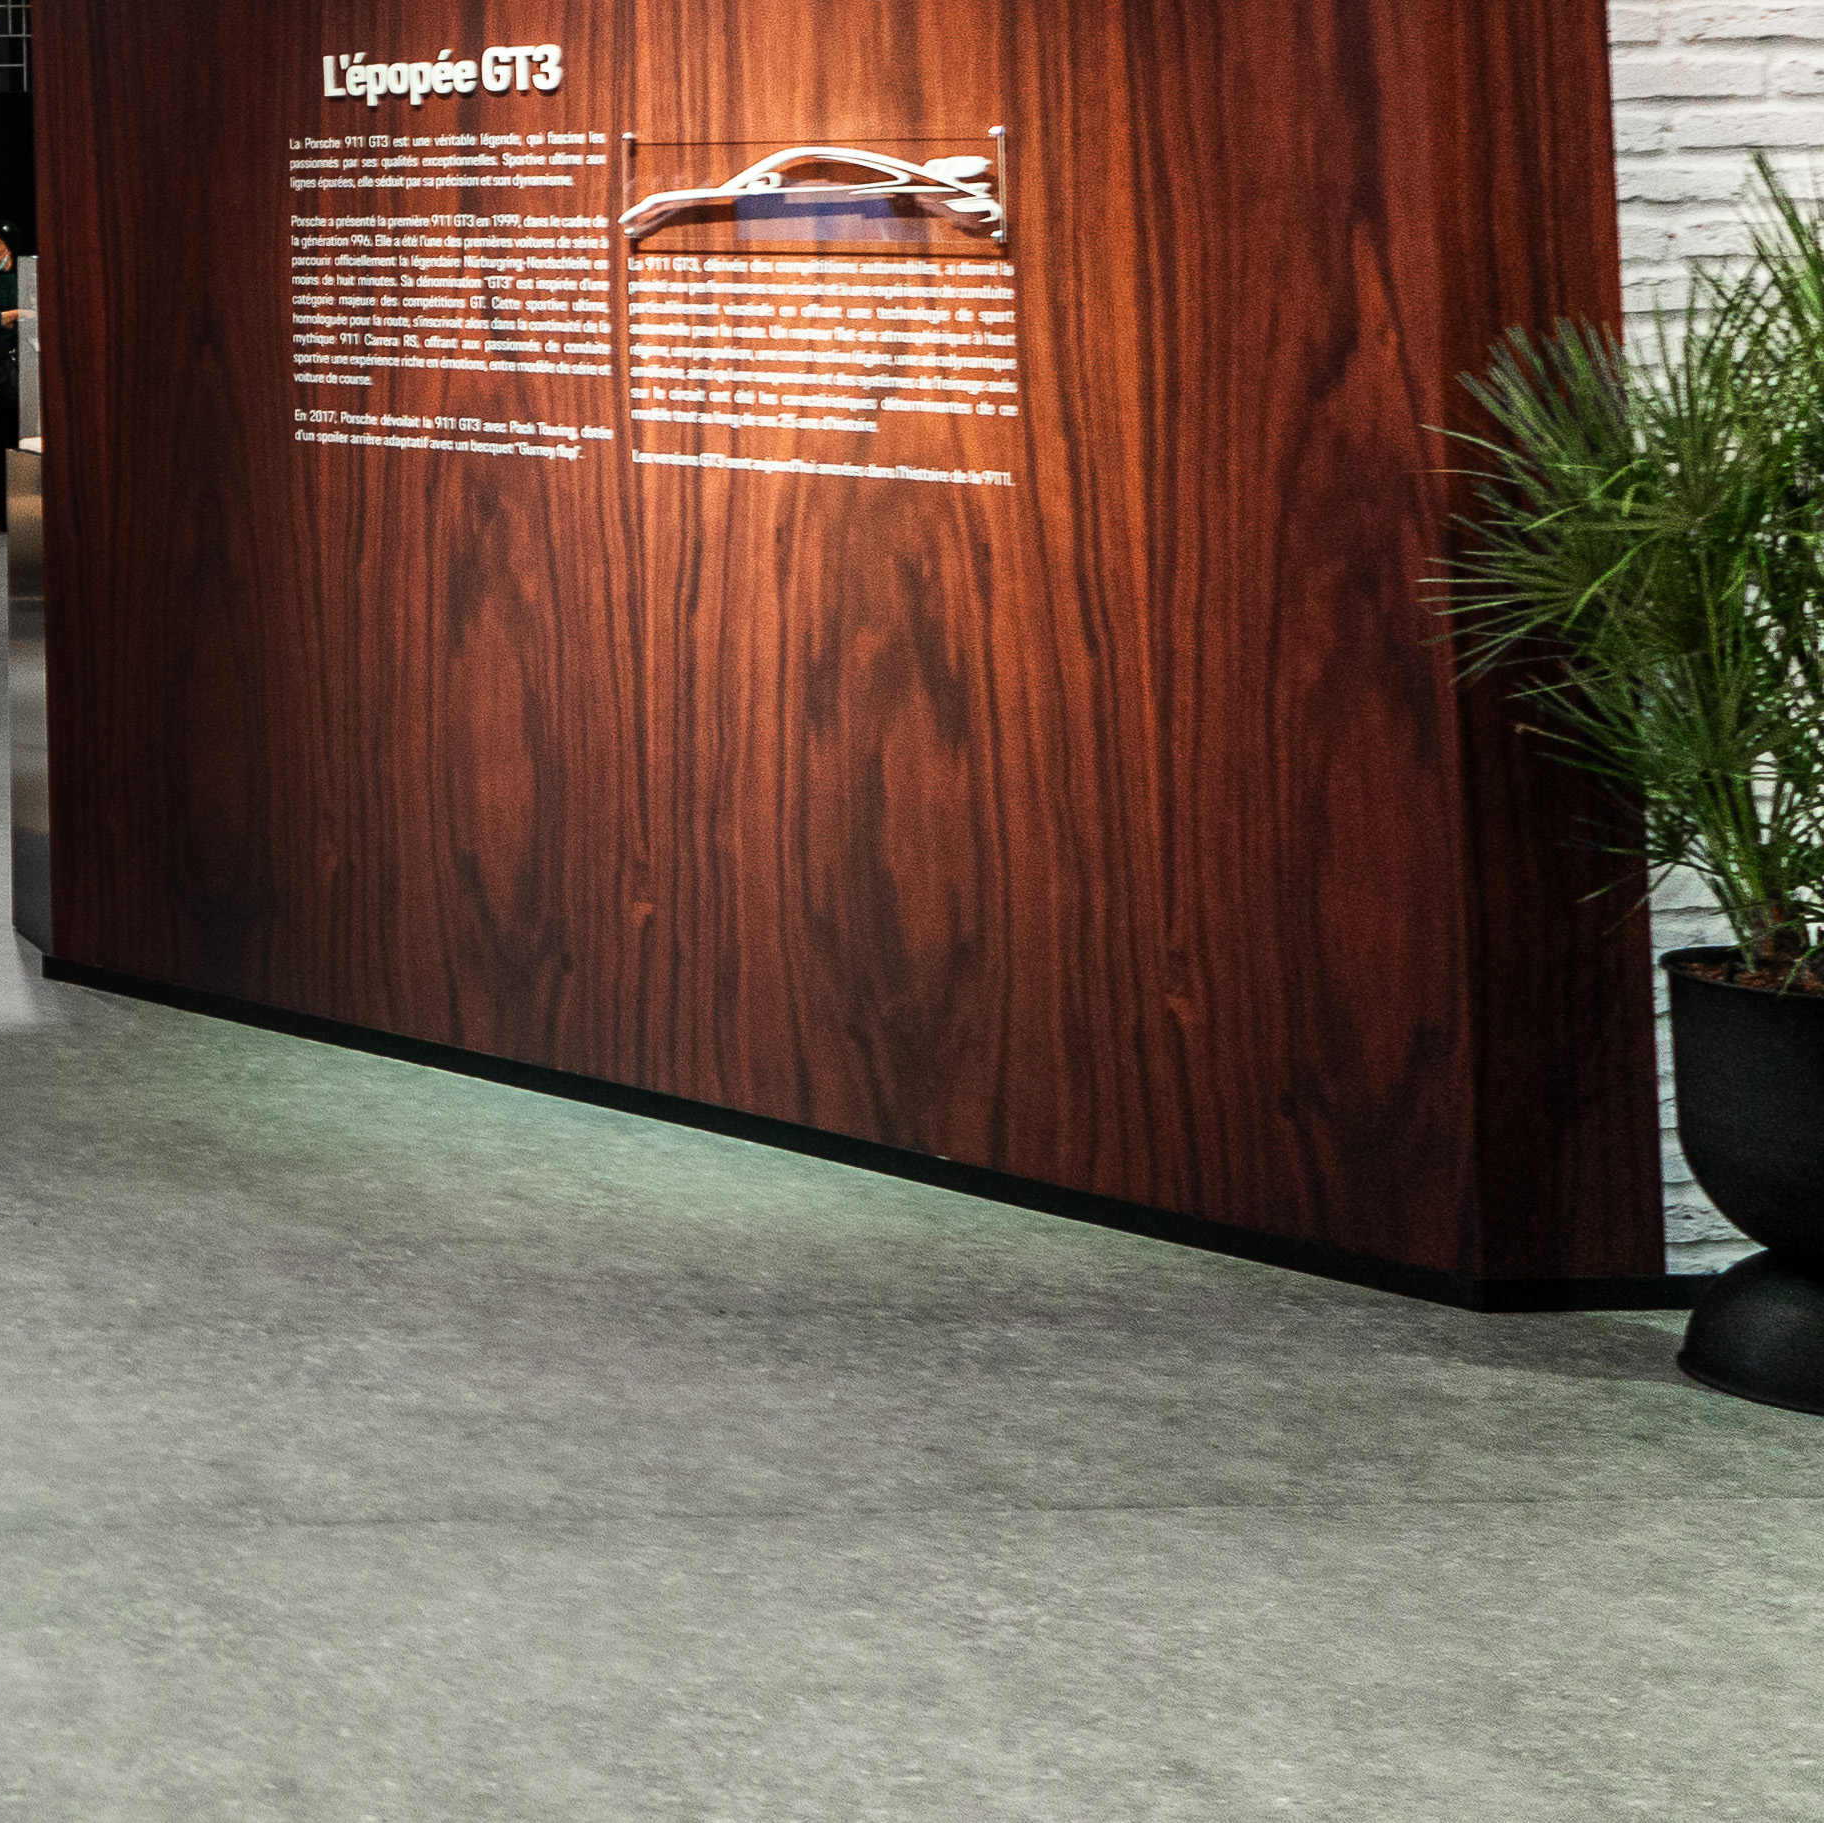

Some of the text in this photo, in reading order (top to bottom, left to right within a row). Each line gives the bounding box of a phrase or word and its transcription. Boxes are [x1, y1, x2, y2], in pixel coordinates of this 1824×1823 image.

[323, 44, 563, 107] L'épopée GT3
[289, 132, 607, 150] La Porsche 911 GT3 est une véritable légende, qui fascine les
[289, 154, 606, 171] passionnés par ses qualités exceptionnelles. Sportive ultime aux
[290, 175, 573, 190] lignes épurées, elle séduit par sa précision et son dynamisme.
[293, 333, 419, 351] mythique 911 Carrera RS,
[294, 409, 614, 440] En 2017, Porsche dévoilait la 911 GT3 avec Pack Touring, dotée
